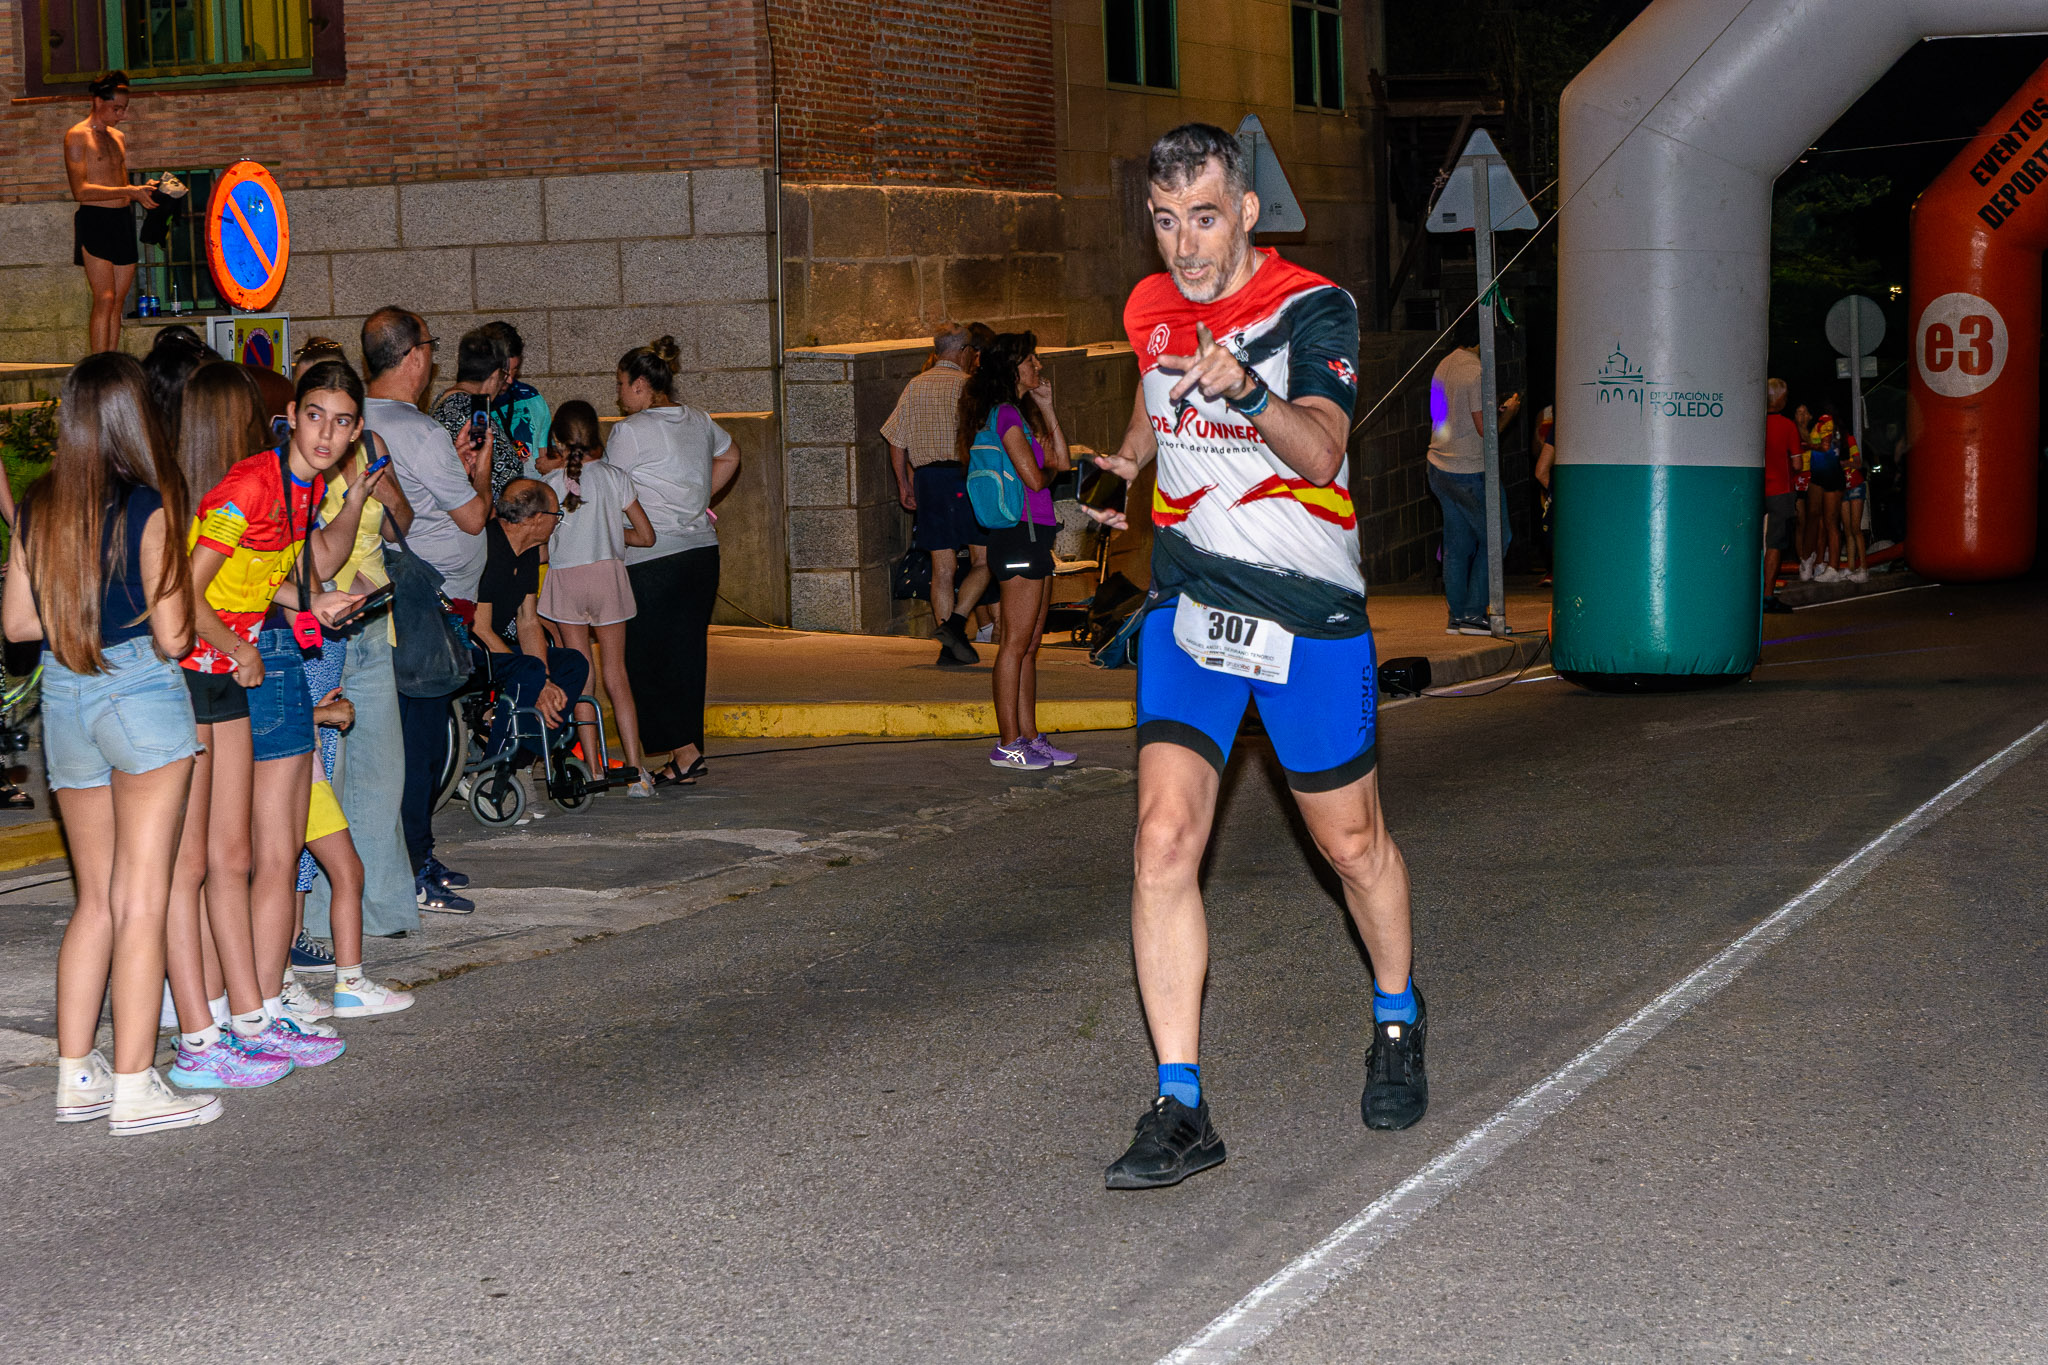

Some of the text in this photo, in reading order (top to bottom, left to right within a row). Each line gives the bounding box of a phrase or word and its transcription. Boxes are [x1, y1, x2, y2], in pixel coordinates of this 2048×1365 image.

[1969, 98, 2048, 187] EVENTOS
[1977, 139, 2048, 230] DEPORT
[1925, 315, 1994, 376] e3
[1650, 390, 1724, 401] DIPUTACIÓN DE
[1650, 401, 1723, 417] TOLEDO
[1190, 444, 1201, 453] de
[1208, 611, 1258, 646] 307
